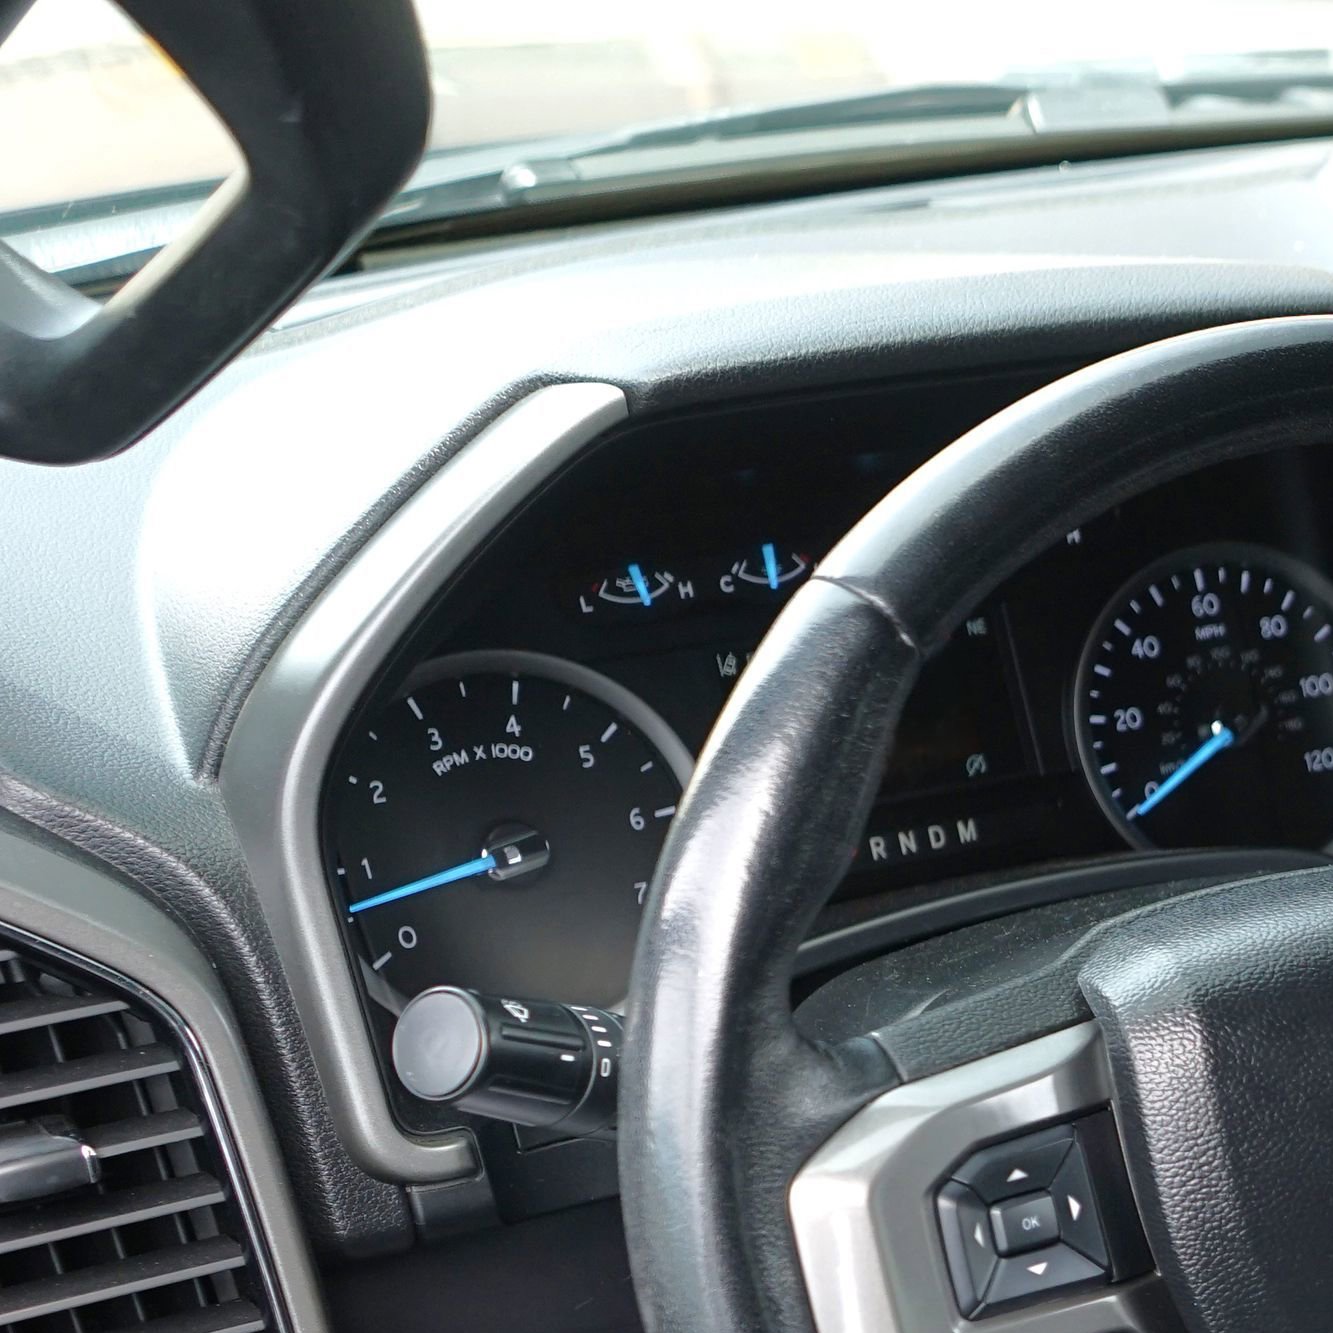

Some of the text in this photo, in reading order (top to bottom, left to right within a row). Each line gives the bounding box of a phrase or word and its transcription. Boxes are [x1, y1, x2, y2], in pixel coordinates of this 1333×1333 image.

[678, 580, 695, 599] H
[719, 574, 735, 593] C
[579, 595, 594, 613] L
[1191, 592, 1221, 619] 60
[1194, 623, 1227, 641] MPH
[1259, 614, 1289, 640] 80
[1131, 635, 1161, 660] 40
[506, 714, 521, 737] 4
[1113, 706, 1144, 732] 20
[427, 727, 443, 751] 3
[432, 742, 534, 777] RPM X 1000
[579, 744, 595, 769] 5
[369, 780, 387, 804] 2
[629, 807, 645, 831] 6
[869, 817, 979, 861] R N D M
[361, 857, 373, 880] 1
[633, 881, 648, 905] 7
[398, 925, 418, 949] 0
[1022, 1216, 1041, 1231] OK
